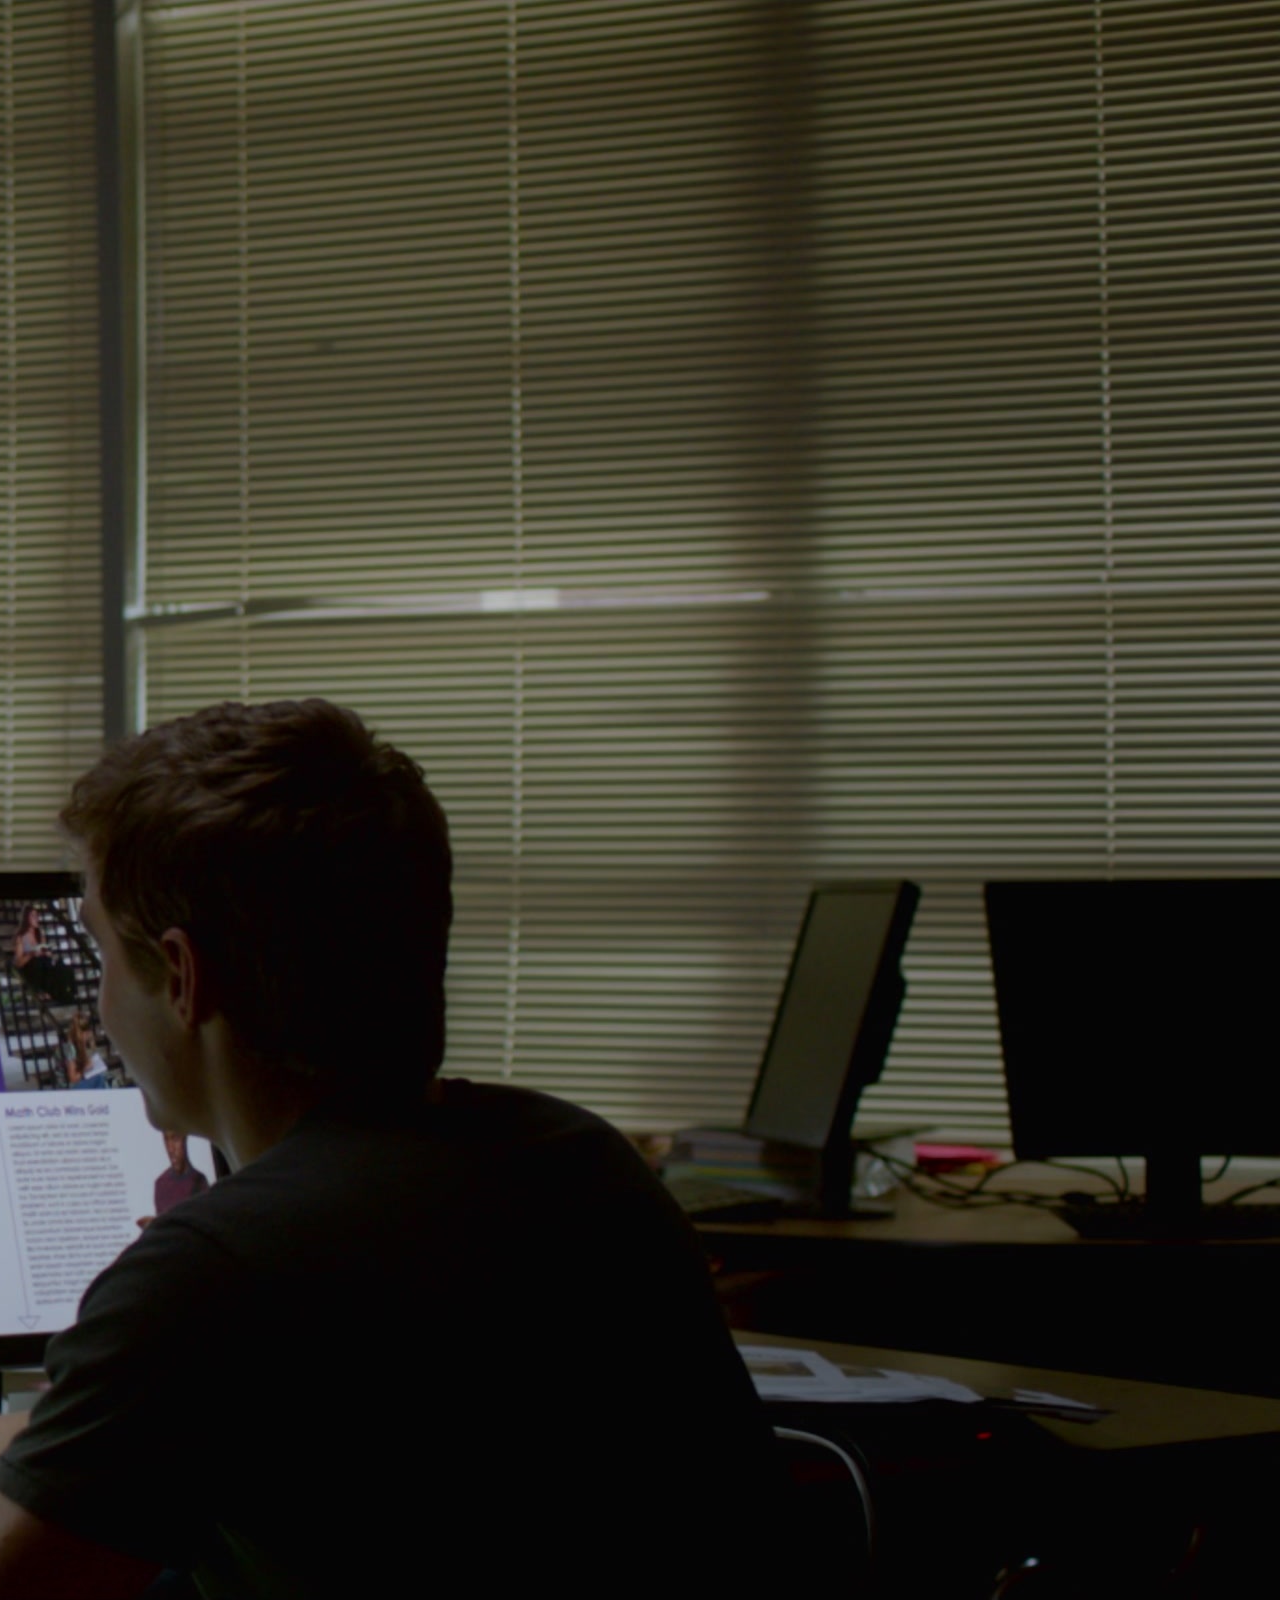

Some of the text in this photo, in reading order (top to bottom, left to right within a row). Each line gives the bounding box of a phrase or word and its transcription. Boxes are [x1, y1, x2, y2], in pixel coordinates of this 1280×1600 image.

[5, 1106, 34, 1118] Math
[36, 1105, 62, 1117] Club
[87, 1103, 110, 1115] Gold
